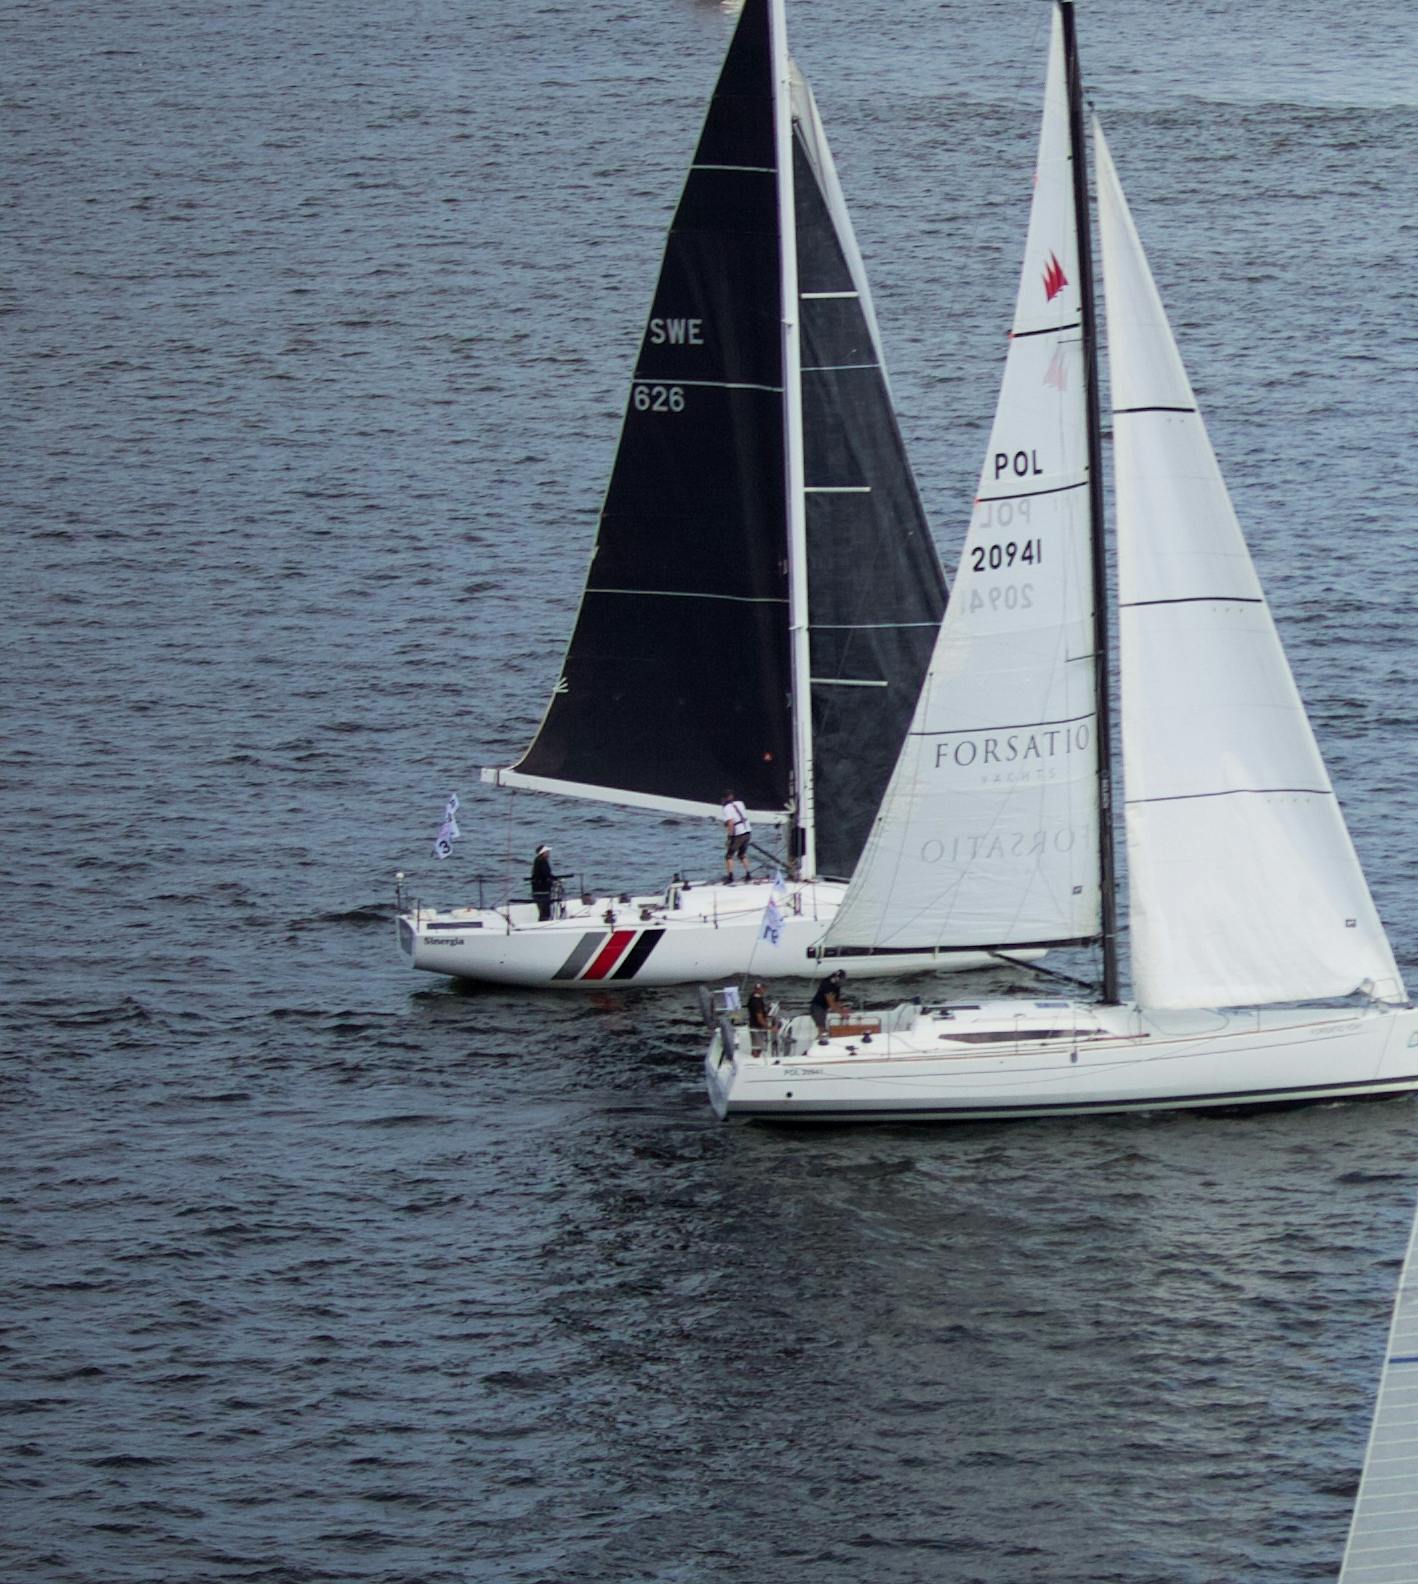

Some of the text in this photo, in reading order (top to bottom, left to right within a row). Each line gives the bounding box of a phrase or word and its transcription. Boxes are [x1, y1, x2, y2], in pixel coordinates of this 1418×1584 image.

[650, 318, 704, 345] SWE
[634, 385, 685, 413] 626
[995, 450, 1043, 480] POL
[971, 539, 1042, 572] 20941
[935, 724, 1090, 768] FORSATIO
